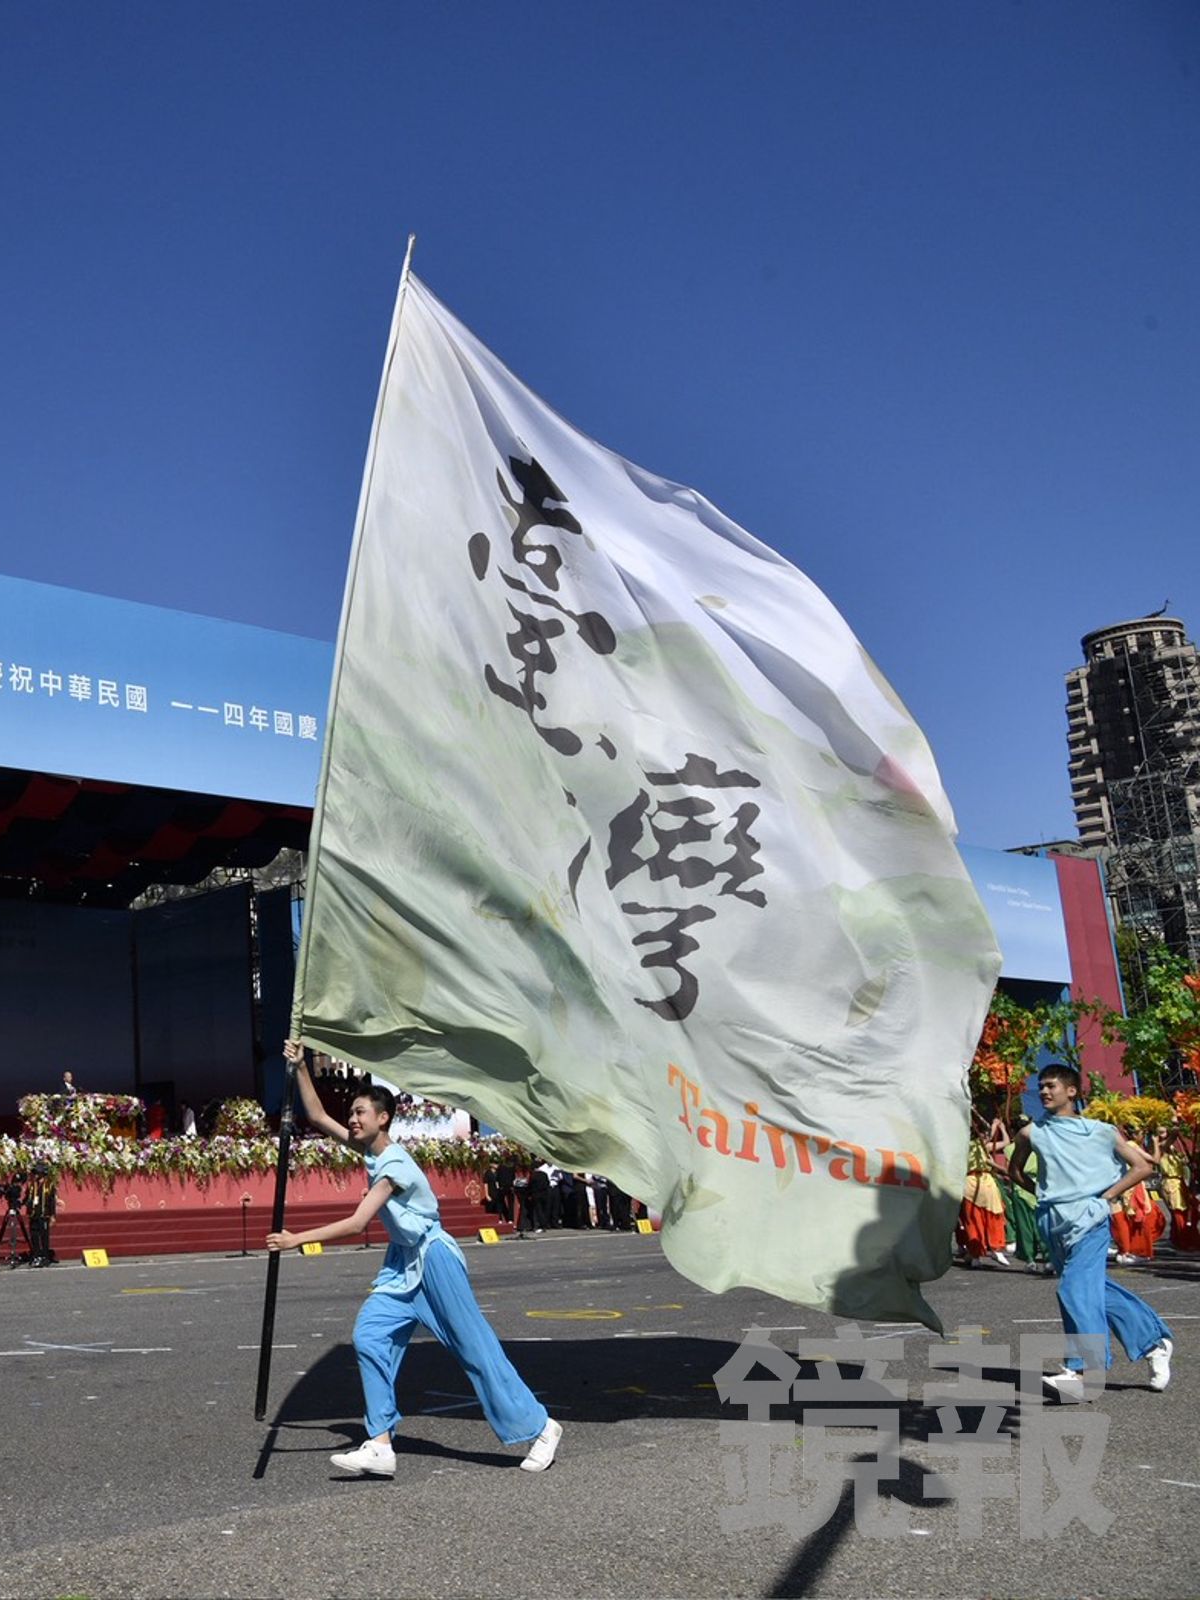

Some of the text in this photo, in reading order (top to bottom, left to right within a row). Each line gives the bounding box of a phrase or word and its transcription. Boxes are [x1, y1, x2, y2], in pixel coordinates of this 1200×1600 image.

[170, 700, 319, 741] 一一四年國慶
[667, 1062, 929, 1191] Taiwan
[91, 1251, 101, 1265] 5
